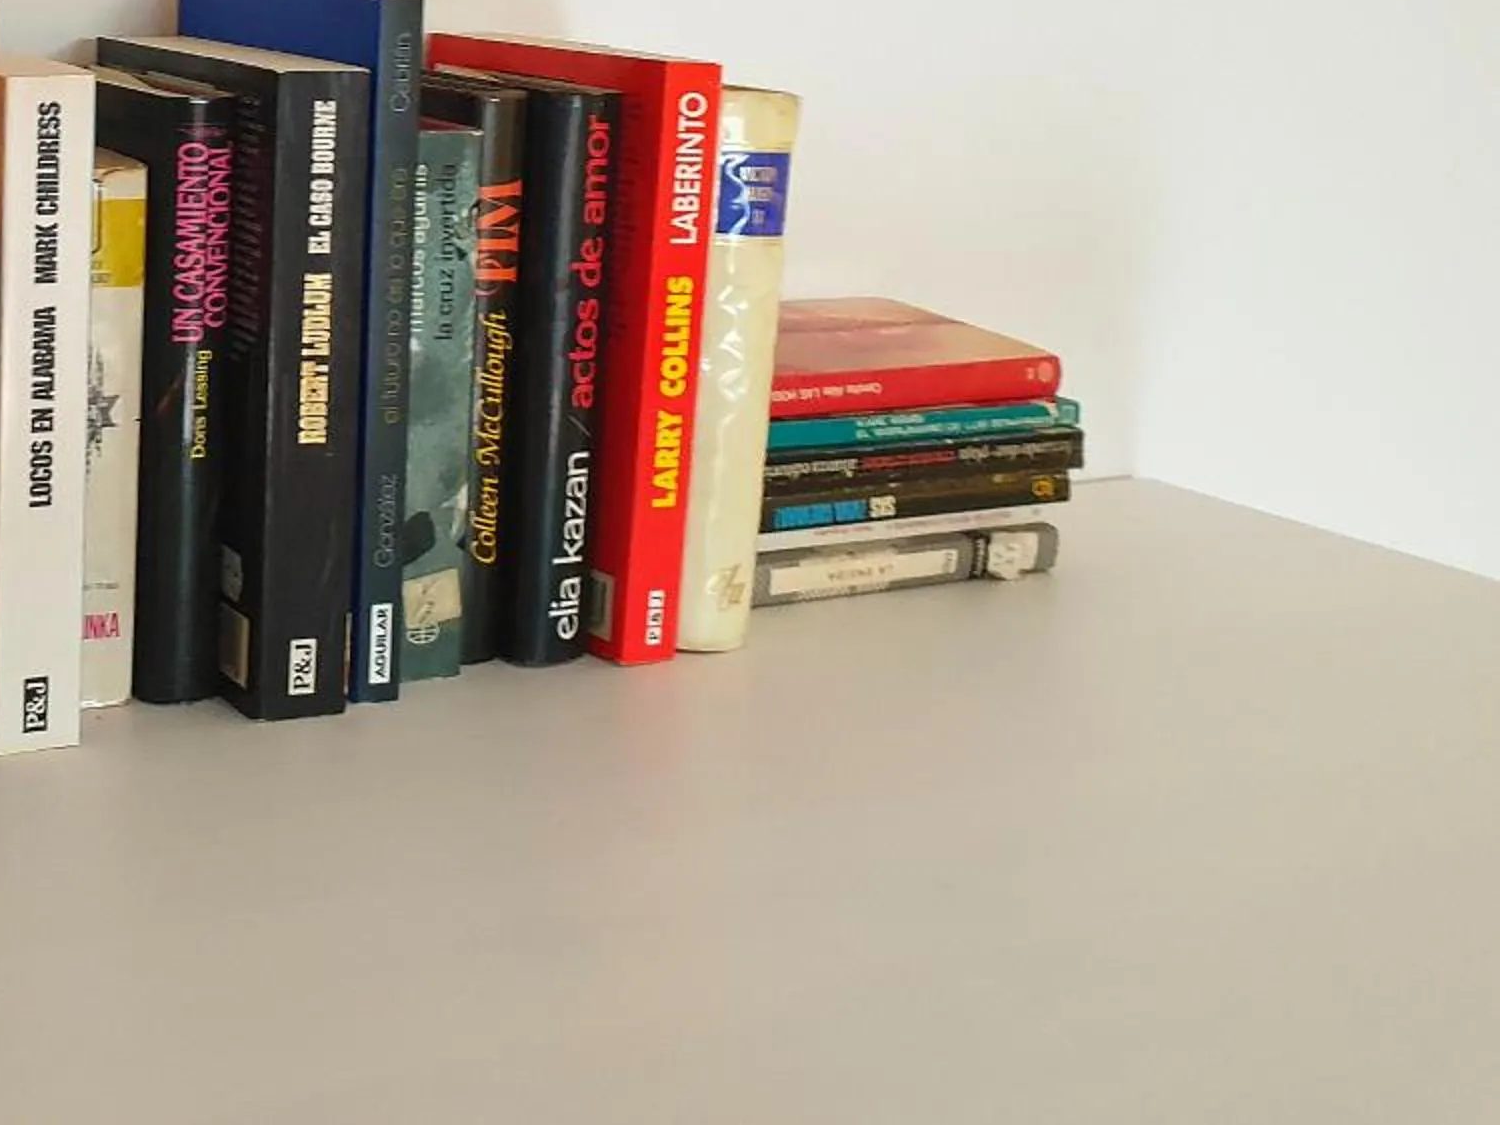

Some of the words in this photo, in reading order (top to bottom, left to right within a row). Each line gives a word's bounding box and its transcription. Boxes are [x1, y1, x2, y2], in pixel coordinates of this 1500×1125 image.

[35, 100, 62, 217] CHILDRESS
[310, 100, 337, 175] BOURNE
[583, 114, 611, 225] amor
[669, 92, 709, 246] LABERINTO
[172, 142, 210, 302] CASAMIENTO
[203, 141, 234, 328] CONVENCIONAL
[308, 178, 335, 227] CASO
[435, 163, 457, 261] invertida
[33, 223, 59, 284] MARK
[307, 230, 332, 254] EL
[567, 235, 606, 288] de
[172, 308, 205, 343] UN
[301, 273, 333, 357] LUDLUM
[439, 268, 455, 317] cruz
[31, 306, 57, 401] ALABAMA
[434, 322, 453, 341] la
[567, 297, 600, 410] actos
[659, 275, 694, 398] COLLINS
[190, 349, 213, 410] Lessing
[297, 360, 329, 444] ROBERT
[476, 311, 513, 466] McCullough
[30, 407, 55, 434] EN
[189, 415, 207, 458] Doris
[29, 439, 54, 508] LOCOS
[651, 409, 684, 509] LARRY
[470, 475, 499, 565] Colleen
[552, 450, 591, 565] kazan
[374, 608, 389, 679] AGUILAR
[547, 575, 582, 641] elia
[293, 643, 313, 690] P&J
[25, 681, 47, 729] P&J
